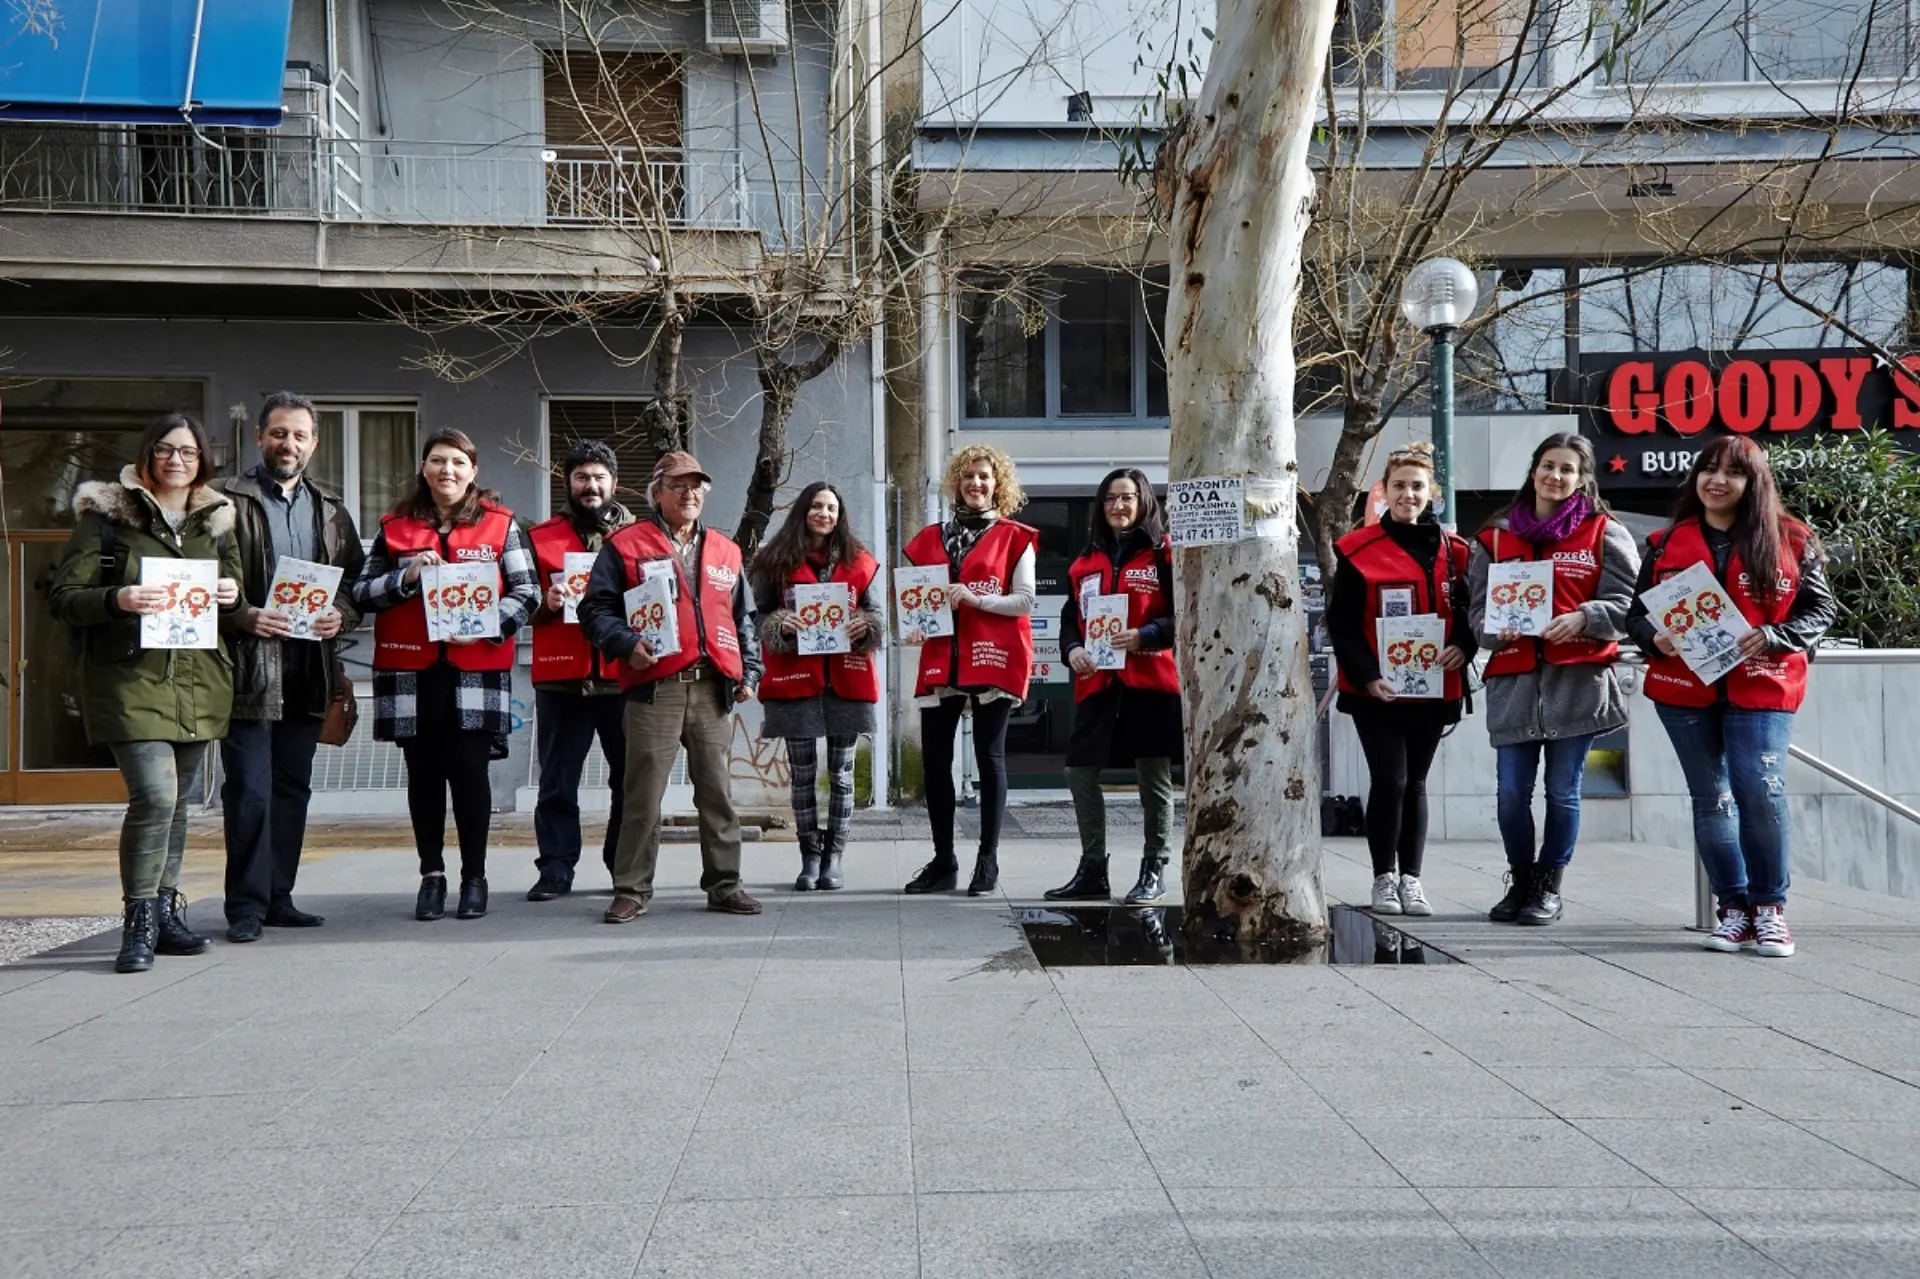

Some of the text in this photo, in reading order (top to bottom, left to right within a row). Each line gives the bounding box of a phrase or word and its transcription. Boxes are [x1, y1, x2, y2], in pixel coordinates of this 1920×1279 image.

[1179, 491, 1220, 504] ΟΛΑ
[1186, 529, 1197, 540] 47
[1200, 528, 1214, 539] 41
[1219, 526, 1239, 538] 791
